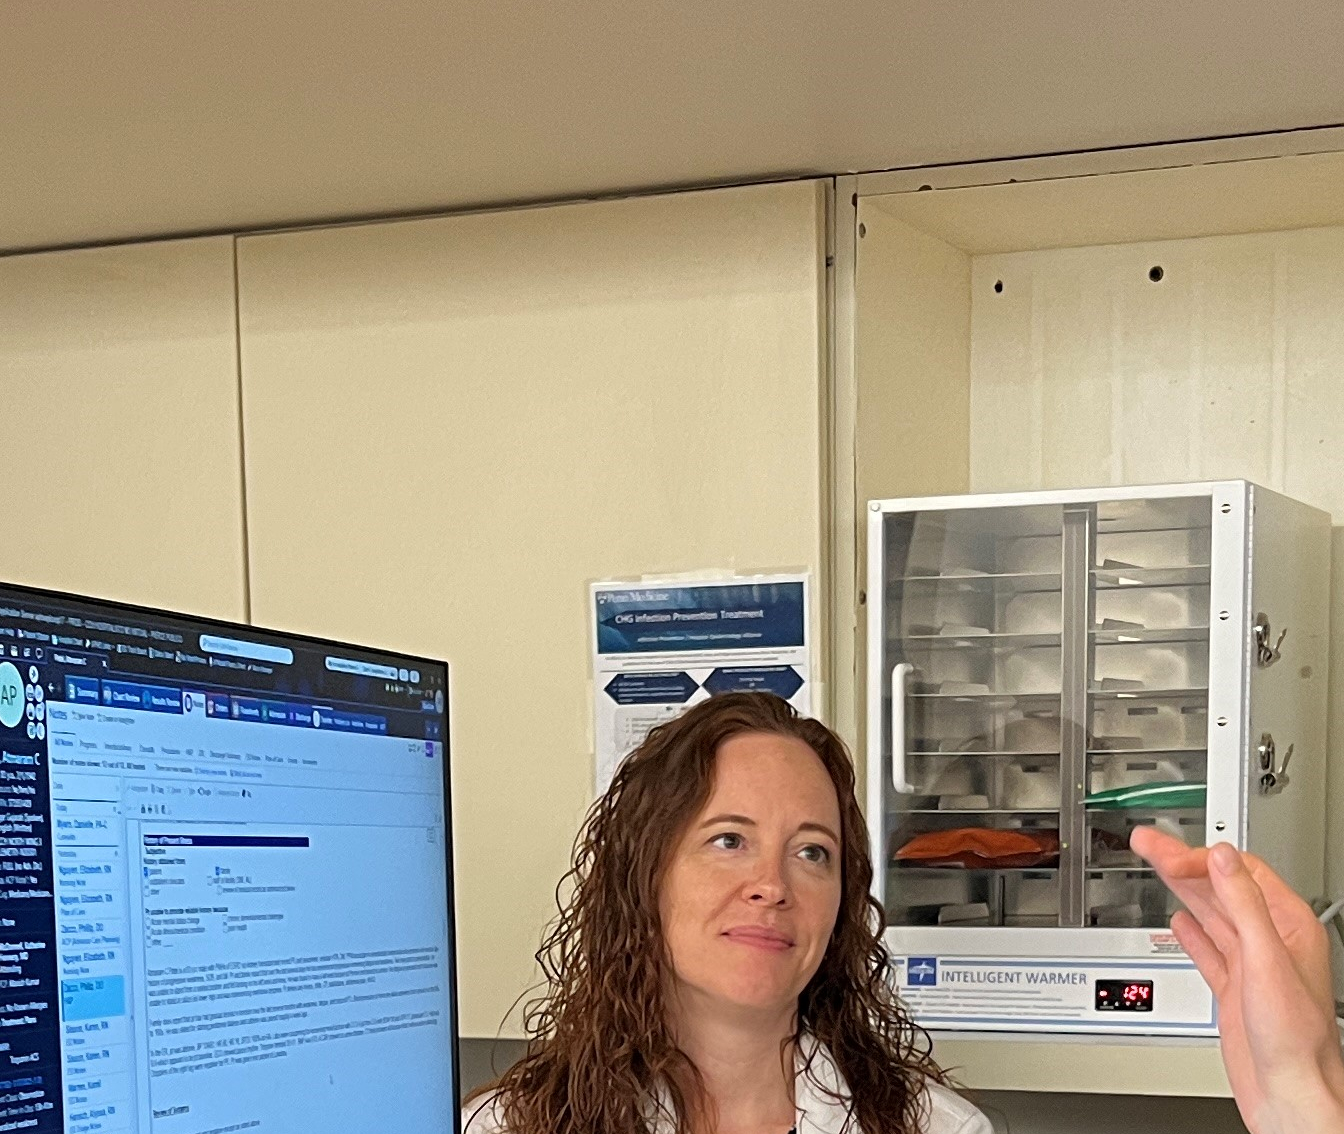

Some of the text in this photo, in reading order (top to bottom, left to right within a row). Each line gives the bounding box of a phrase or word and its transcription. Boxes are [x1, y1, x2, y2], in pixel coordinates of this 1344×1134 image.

[615, 614, 634, 625] CHG
[720, 609, 764, 620] Treatment
[0, 682, 18, 707] AP
[1026, 973, 1087, 985] WARMER
